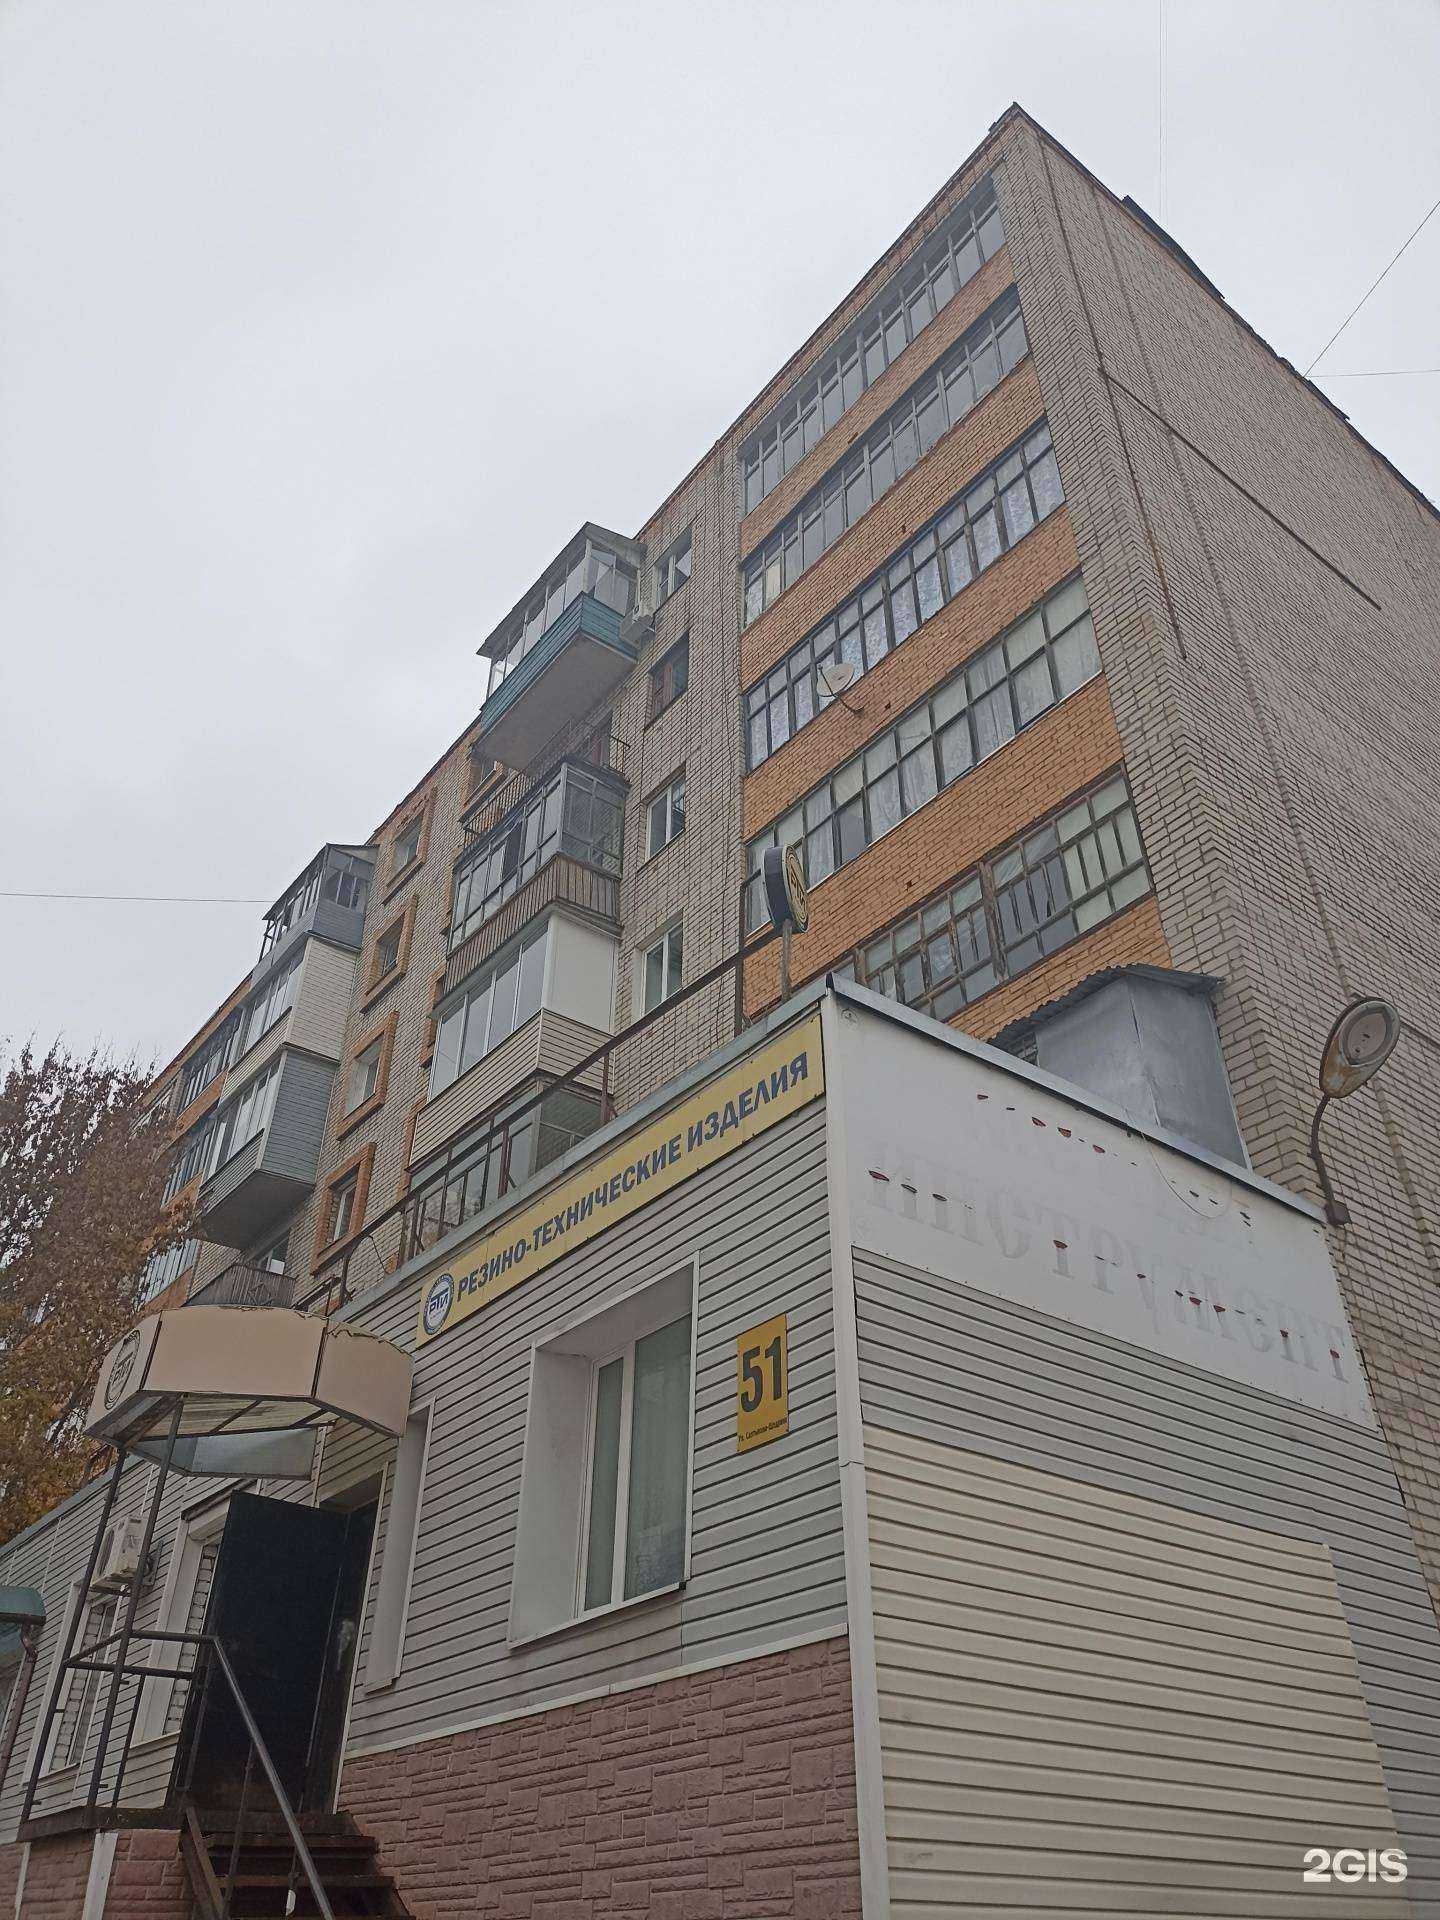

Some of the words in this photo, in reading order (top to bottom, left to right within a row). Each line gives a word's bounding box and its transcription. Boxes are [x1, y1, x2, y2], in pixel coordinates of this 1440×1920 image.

[457, 1134, 682, 1302] РЕЗИНО-ТЕХНИЧЕСКИЕ
[688, 1052, 808, 1153] ИЗДЕЛИЯ
[741, 1336, 782, 1413] 51
